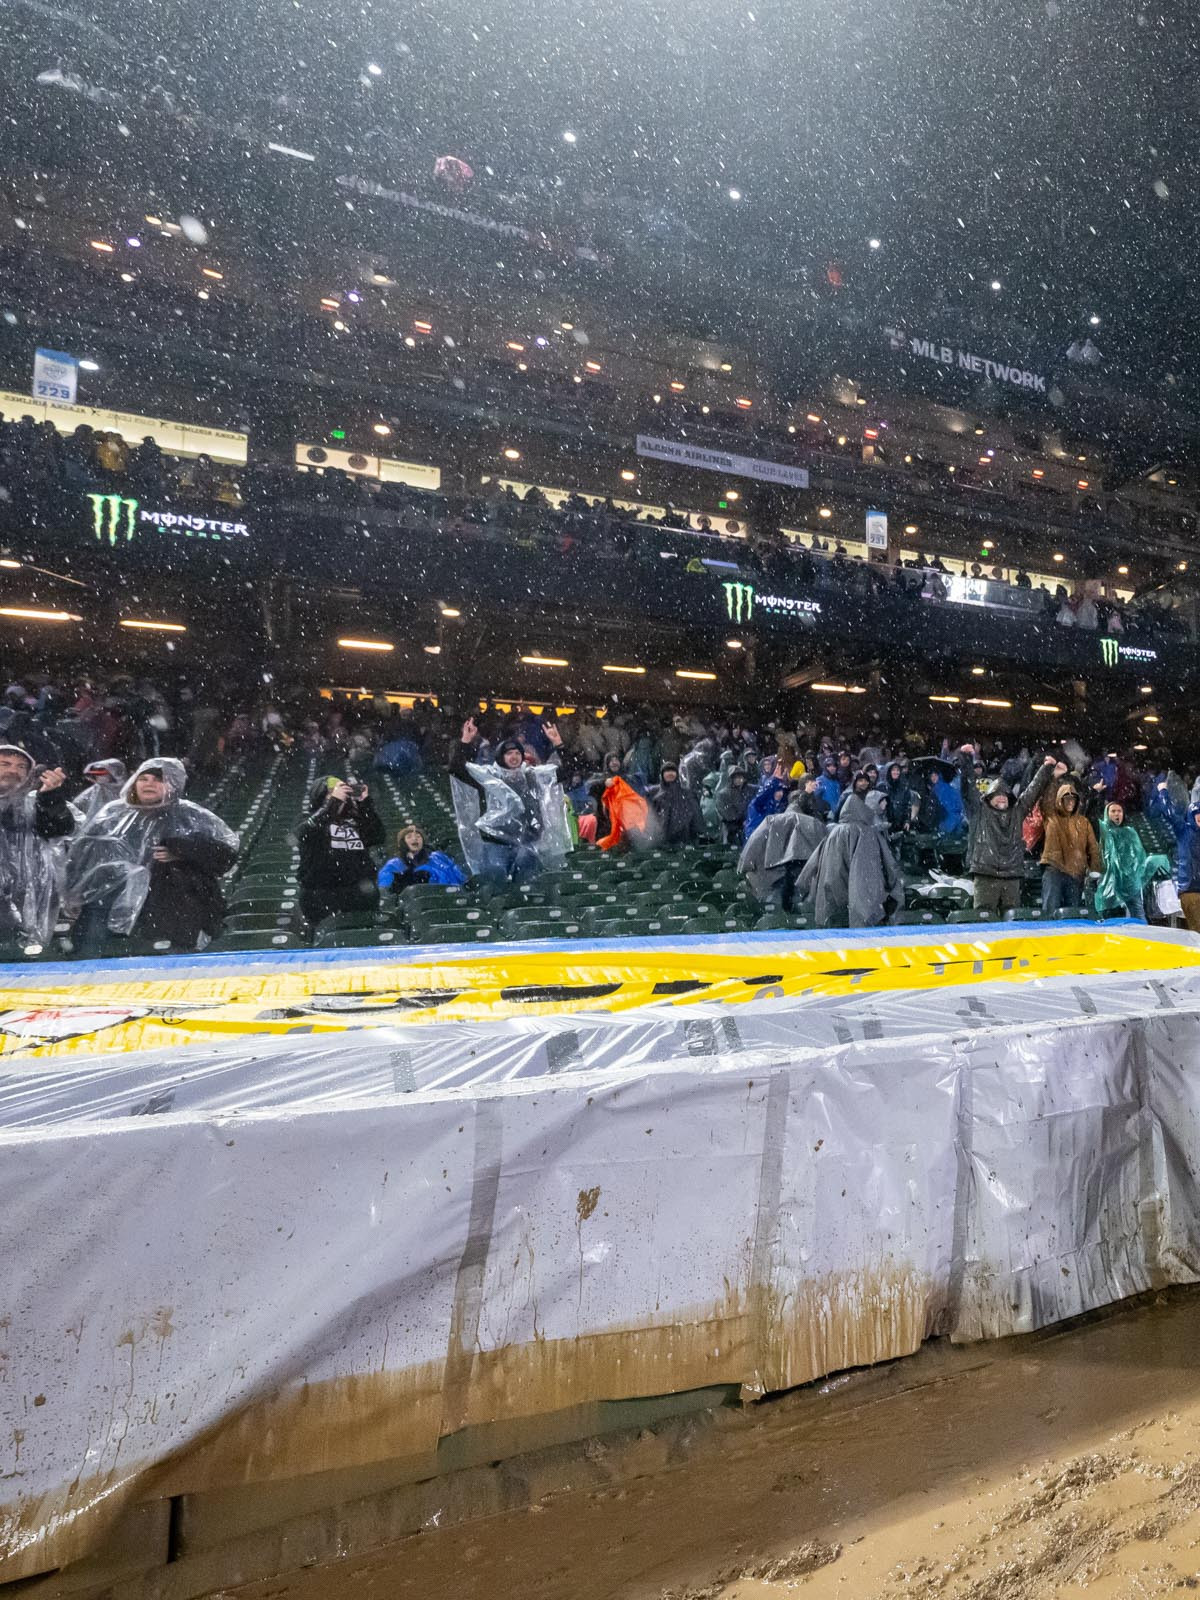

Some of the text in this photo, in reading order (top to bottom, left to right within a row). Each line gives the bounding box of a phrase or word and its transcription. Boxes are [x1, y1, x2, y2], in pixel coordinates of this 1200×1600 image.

[912, 338, 1046, 392] MLB NETWORK
[38, 385, 70, 399] 229
[140, 510, 250, 537] MONSTER
[755, 594, 822, 613] MONSTER
[1118, 646, 1157, 659] MONSTER
